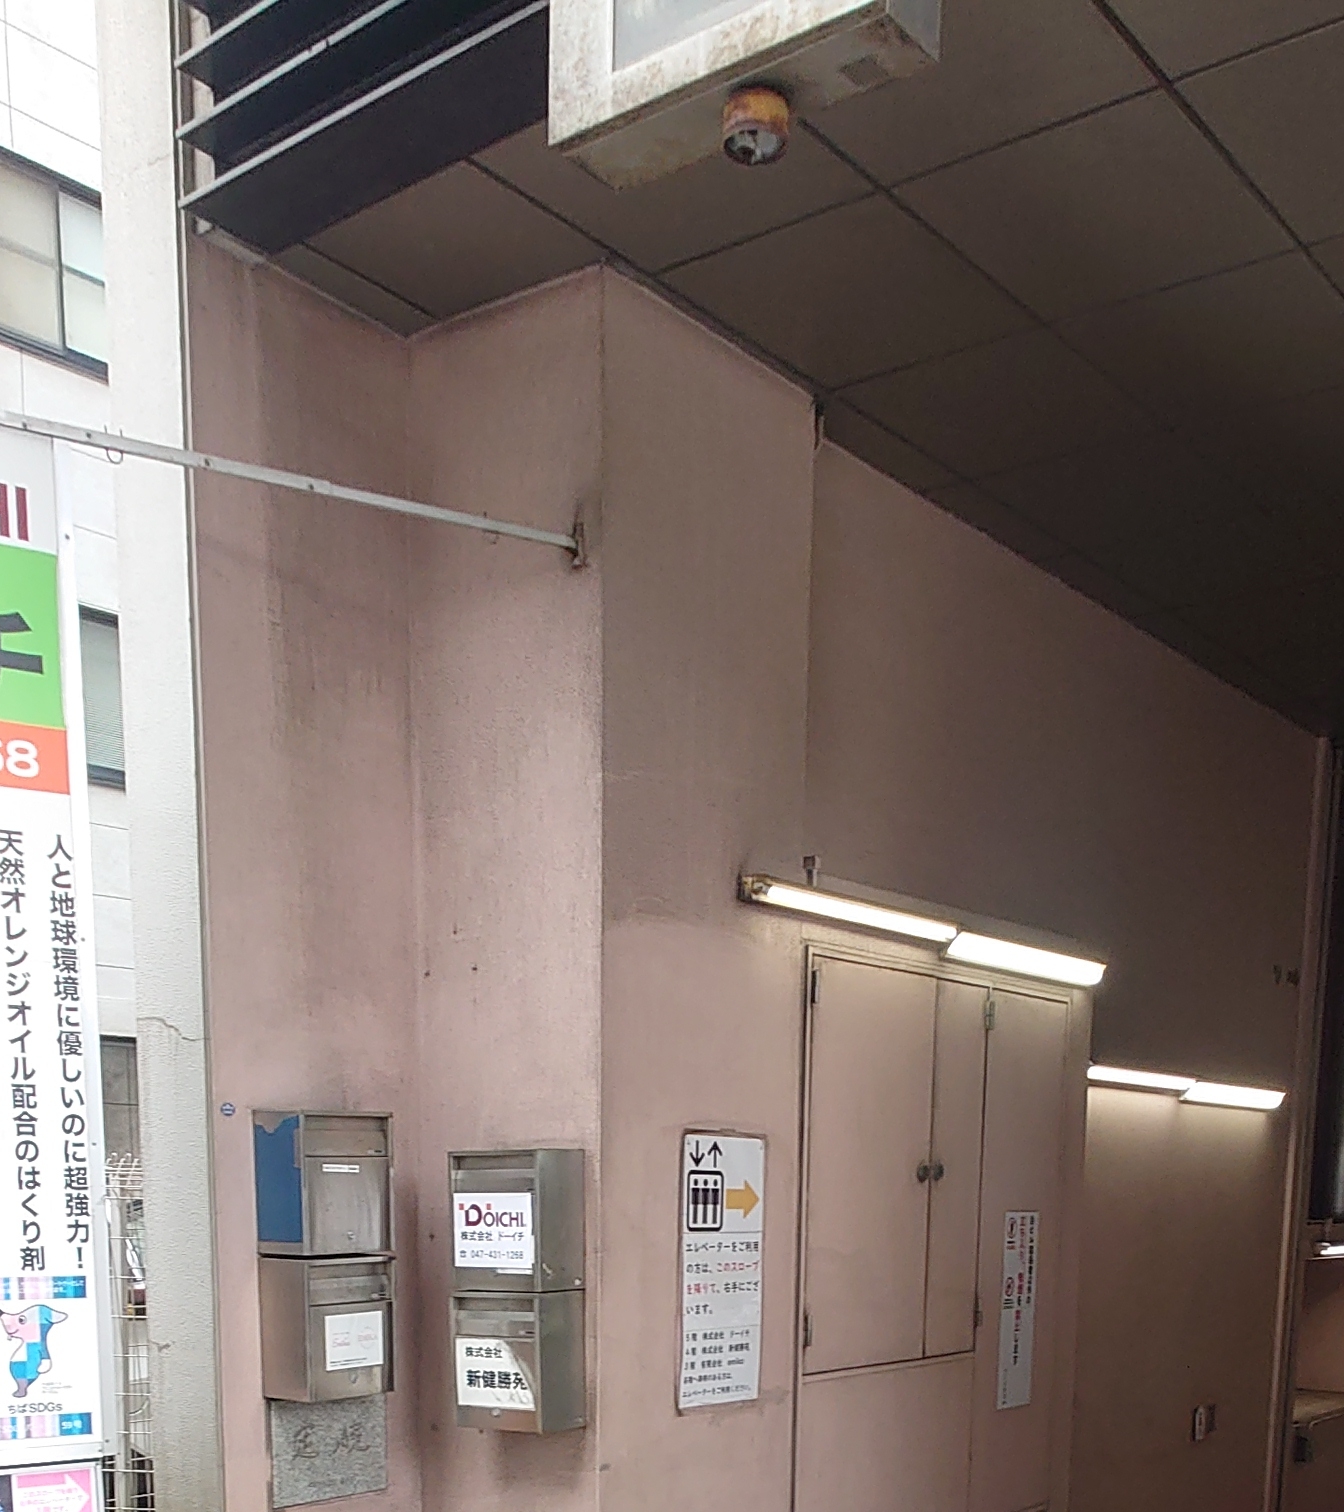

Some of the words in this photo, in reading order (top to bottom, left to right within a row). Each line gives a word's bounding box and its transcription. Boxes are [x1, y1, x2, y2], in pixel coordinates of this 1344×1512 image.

[464, 1203, 526, 1228] DOICHI
[460, 1231, 493, 1242] 株式会社
[465, 1347, 503, 1359] 株式会社
